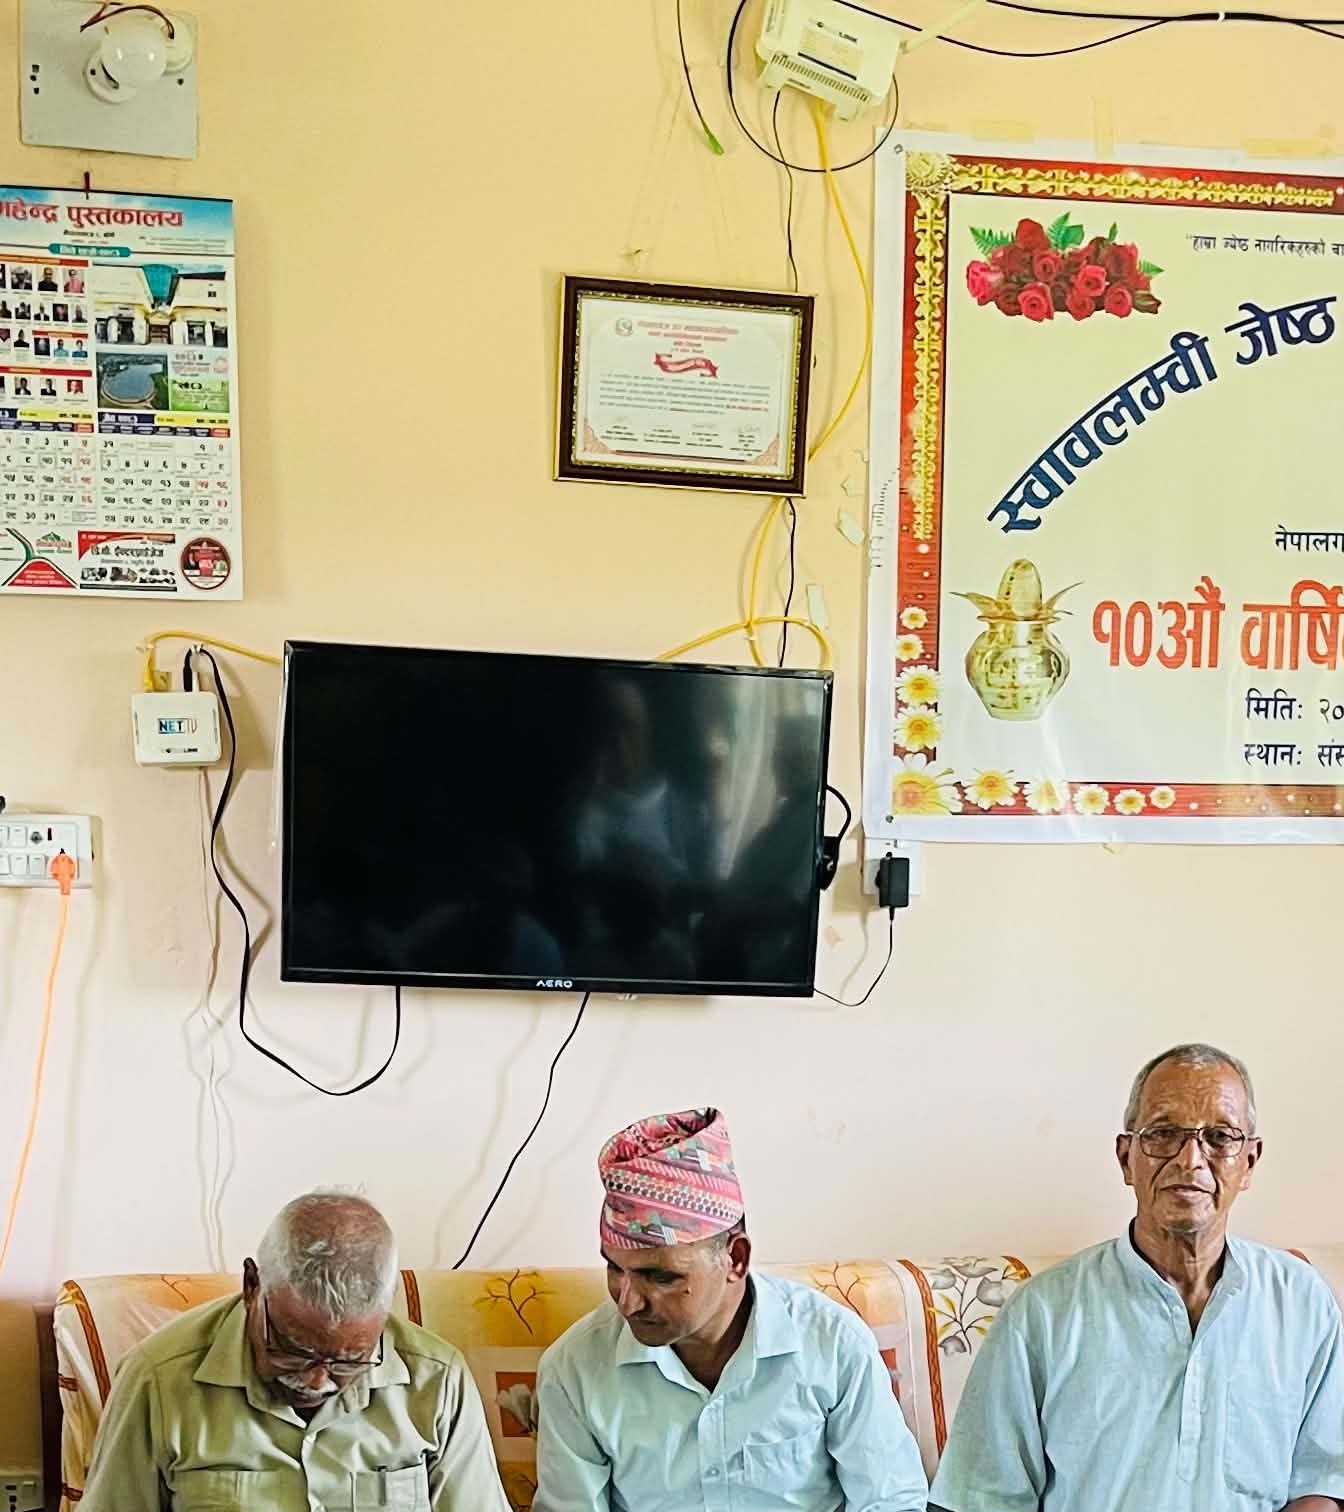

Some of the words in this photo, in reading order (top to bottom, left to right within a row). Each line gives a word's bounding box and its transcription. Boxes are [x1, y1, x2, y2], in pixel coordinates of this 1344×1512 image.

[66, 205, 184, 228] पुस्तकालय
[1224, 301, 1337, 366] जेष्ठ
[1245, 688, 1303, 720] मिति:
[1244, 743, 1302, 768] स्थान:
[536, 980, 573, 988] AERO
